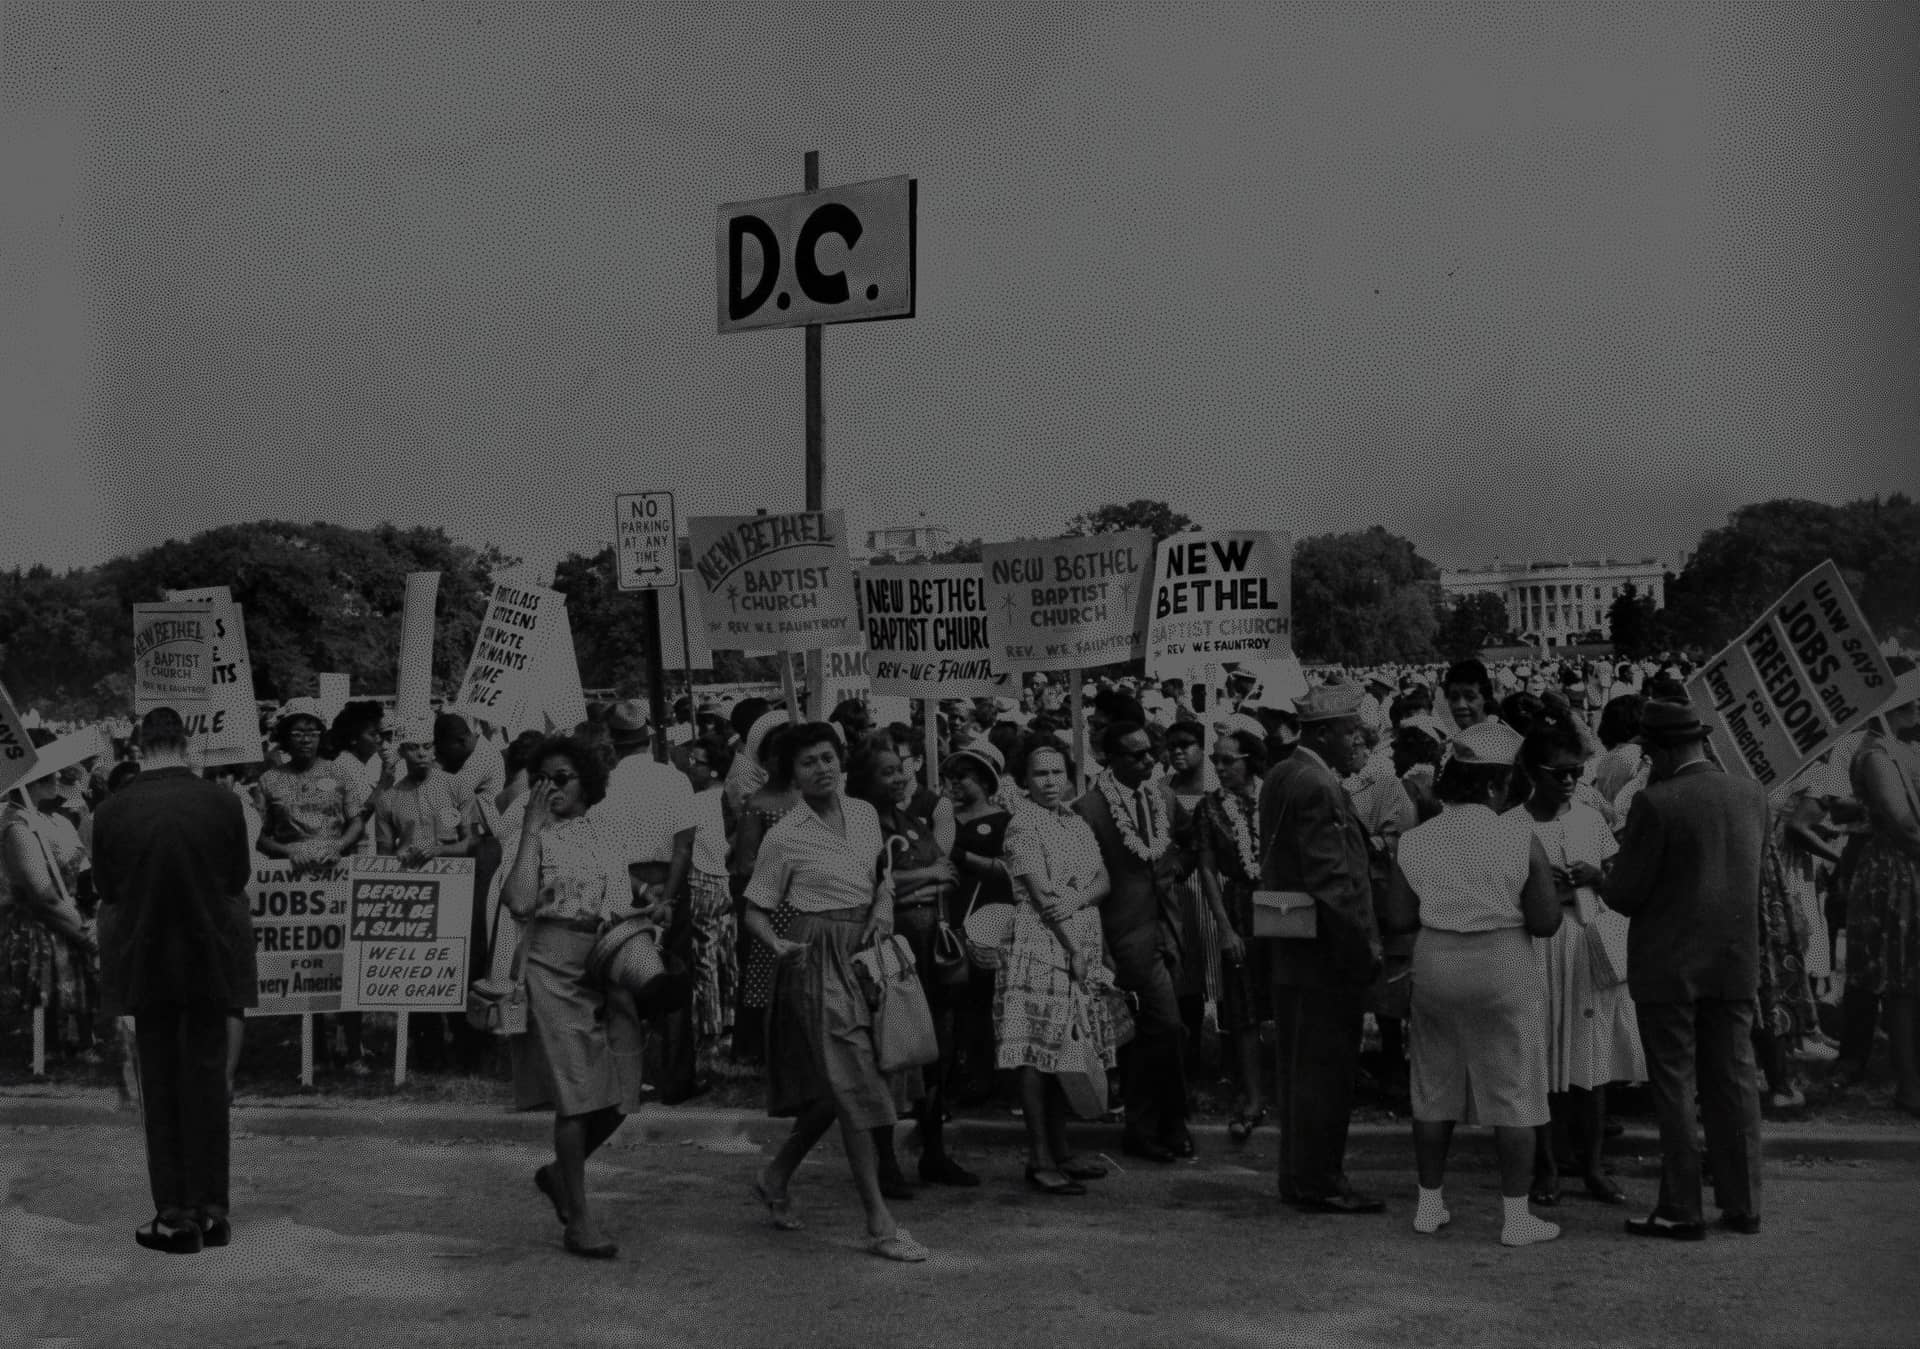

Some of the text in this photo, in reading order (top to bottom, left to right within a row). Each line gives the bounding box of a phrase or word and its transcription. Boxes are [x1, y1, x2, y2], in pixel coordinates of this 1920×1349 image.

[729, 203, 879, 321] D.C.
[632, 499, 657, 518] NO
[621, 520, 669, 534] PARKING
[624, 535, 667, 549] AT ANY
[697, 513, 836, 591] NEW BETHEL
[635, 551, 659, 563] TIME
[992, 547, 1138, 584] NEW BETHEL
[1167, 540, 1254, 579] NEW
[744, 566, 829, 593] BAPTIST
[508, 589, 541, 611] CLASS
[741, 592, 817, 611] CHURCH
[866, 578, 903, 614] NEW
[909, 577, 987, 615] BETHEL
[1031, 583, 1109, 607] BAPTIST
[1156, 577, 1278, 619] BETHEL
[492, 605, 538, 630] CITIZENS
[779, 616, 847, 633] FAUNTROY
[1030, 604, 1107, 627] CHURCH
[153, 620, 204, 645] BETHEL
[495, 628, 525, 650] VOTE
[868, 617, 929, 651] BAPTIST
[1075, 631, 1142, 654] FAUNTROY
[1151, 617, 1289, 645] BAPTIST CHURCH
[1812, 579, 1884, 689] UAW SAYS
[1214, 638, 1270, 652] FAUNTROY
[154, 650, 199, 668] BAPTIST
[487, 645, 528, 671] WANTS
[1779, 600, 1859, 726] JOBS and
[151, 666, 191, 679] CHURCH
[1746, 622, 1829, 755] FREEDOM
[1746, 689, 1772, 728] FOR
[183, 710, 225, 738] ULE
[1706, 660, 1776, 786] Every American
[249, 890, 326, 917] JOBS
[357, 884, 433, 900] BEFORE
[357, 901, 435, 919] WE'LL BE
[253, 924, 346, 952] FREEDO
[353, 921, 433, 939] A SLAVE,
[291, 958, 324, 970] FOR
[424, 946, 450, 961] BE
[366, 964, 457, 979] BURIED IN
[257, 972, 343, 998] very Americ
[366, 983, 458, 998] OUR GRAVE
